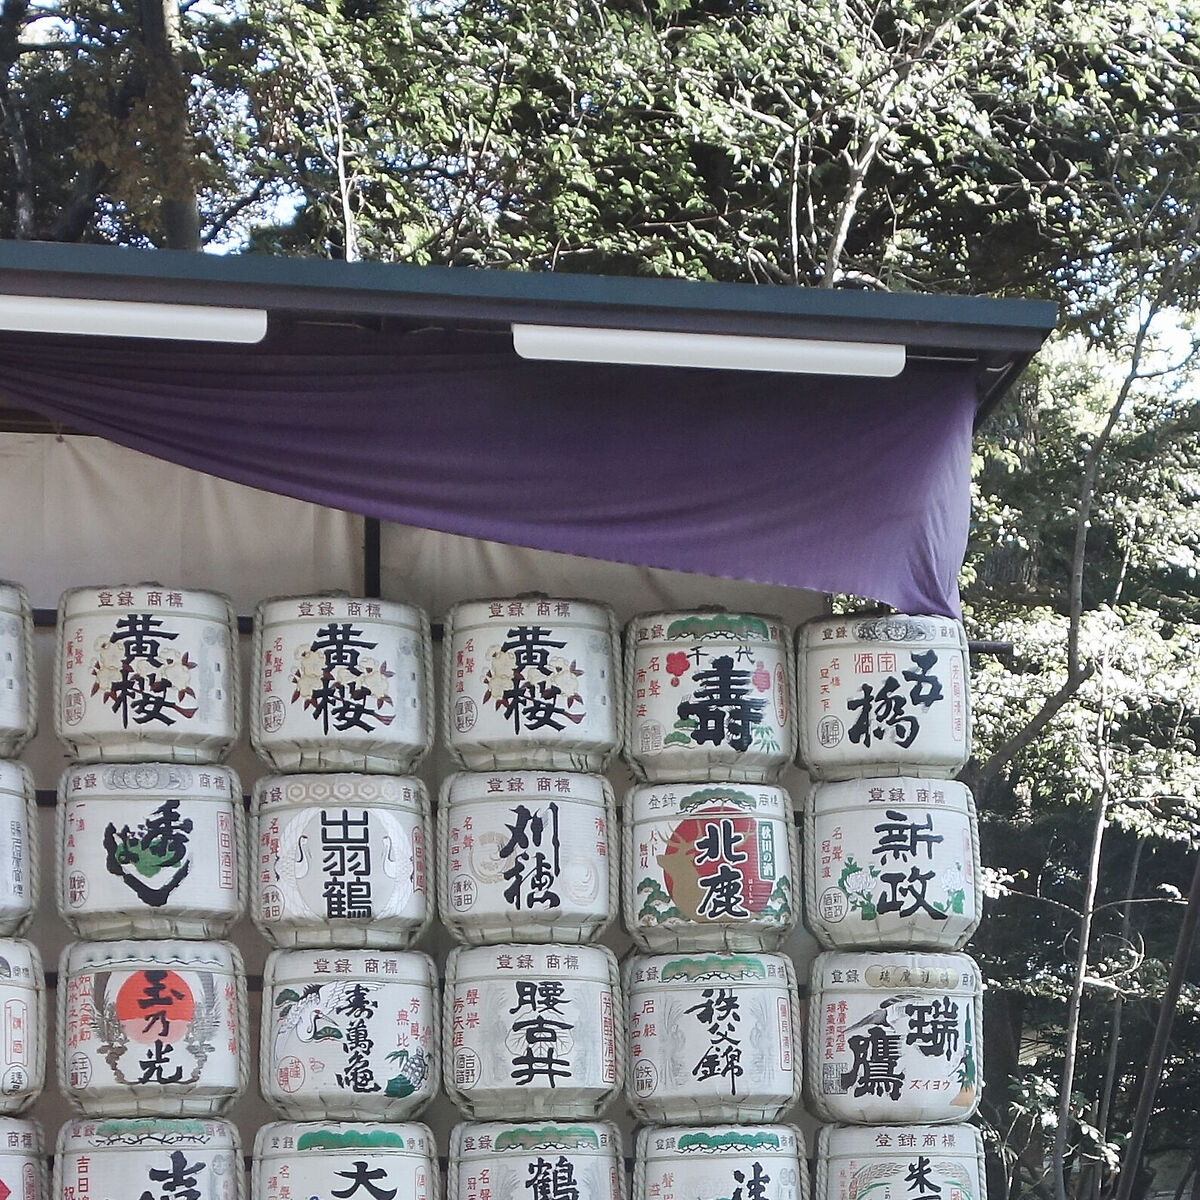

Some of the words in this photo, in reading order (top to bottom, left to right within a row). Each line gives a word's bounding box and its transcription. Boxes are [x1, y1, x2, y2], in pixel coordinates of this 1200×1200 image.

[847, 649, 943, 749] 五橋
[321, 809, 371, 919] 出羽鶴
[695, 819, 749, 918] 北鹿
[762, 826, 772, 876] 秋田の酒
[872, 811, 948, 920] 新政
[139, 970, 185, 1084] 玉乃光
[509, 981, 574, 1088] 腰古井
[684, 988, 743, 1095] 秩父錦
[841, 996, 959, 1100] 瑞鷹
[910, 1080, 950, 1089] ズイヨウ
